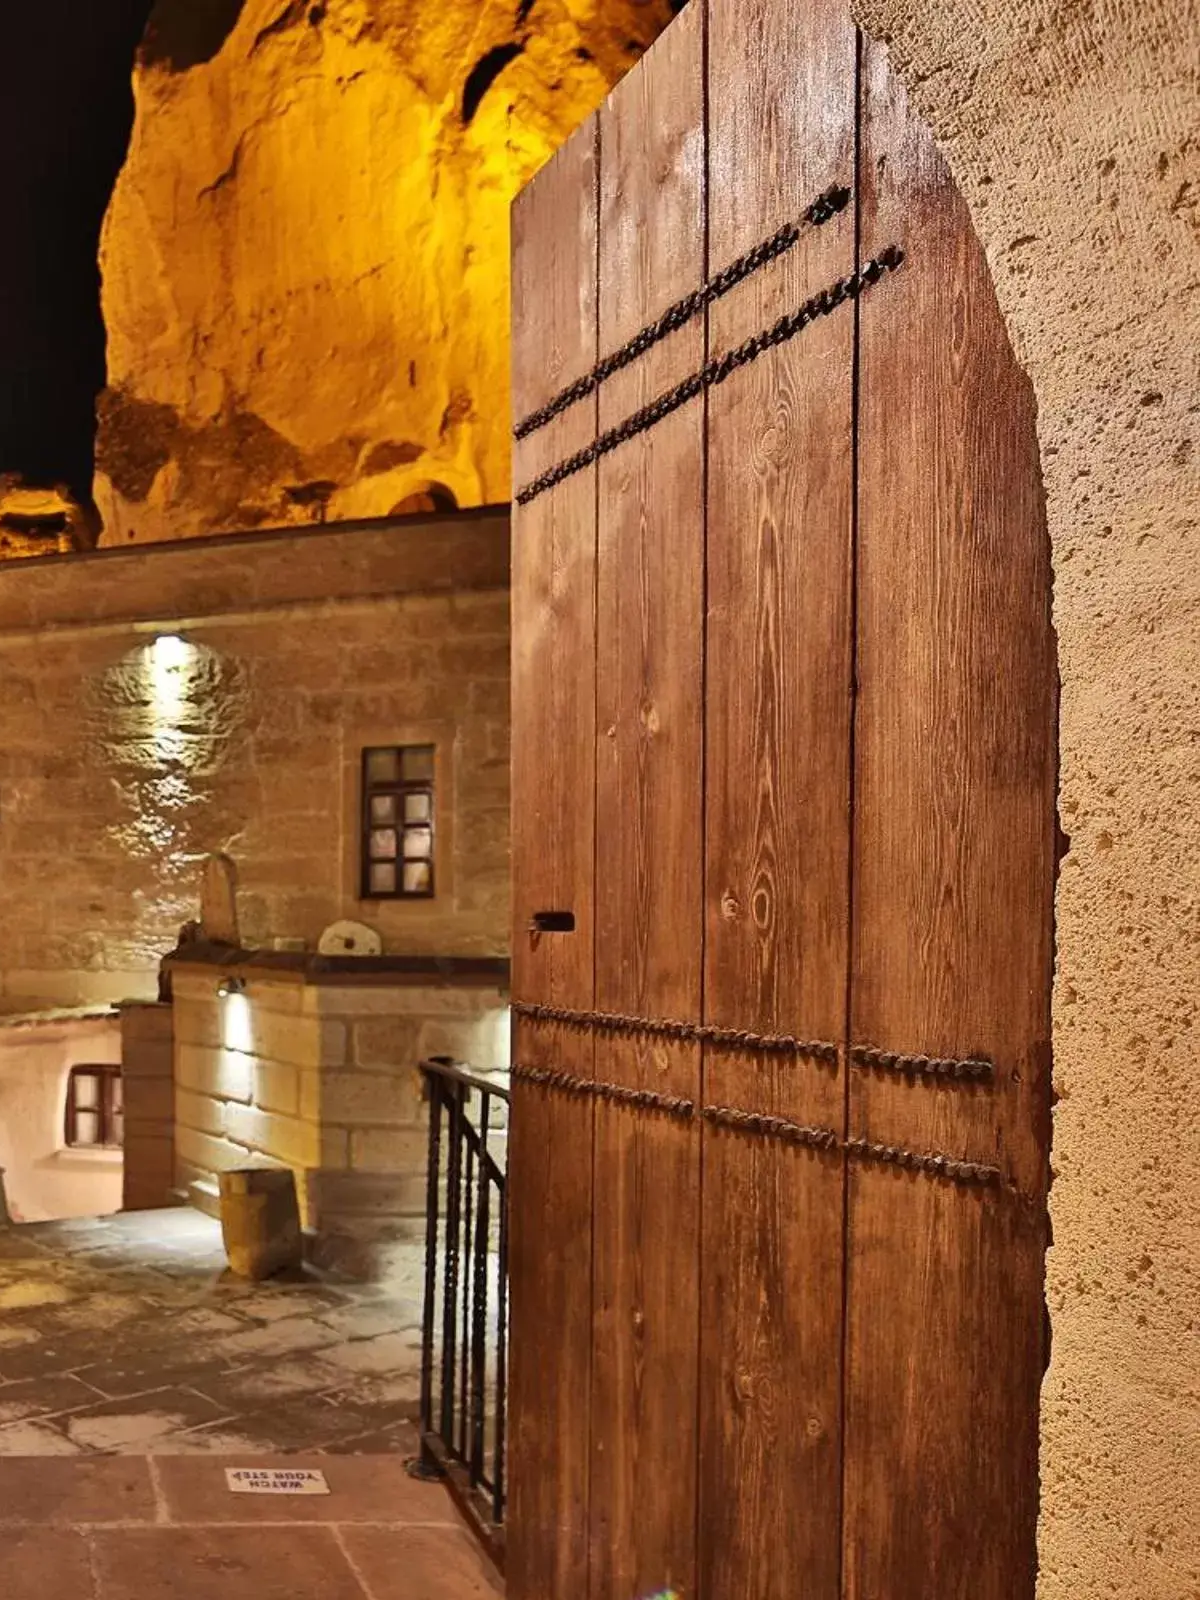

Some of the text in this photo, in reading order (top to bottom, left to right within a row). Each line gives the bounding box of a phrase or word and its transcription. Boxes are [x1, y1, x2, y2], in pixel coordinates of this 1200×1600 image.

[232, 1471, 320, 1482] YOUR STEP
[248, 1480, 304, 1489] WATCH
